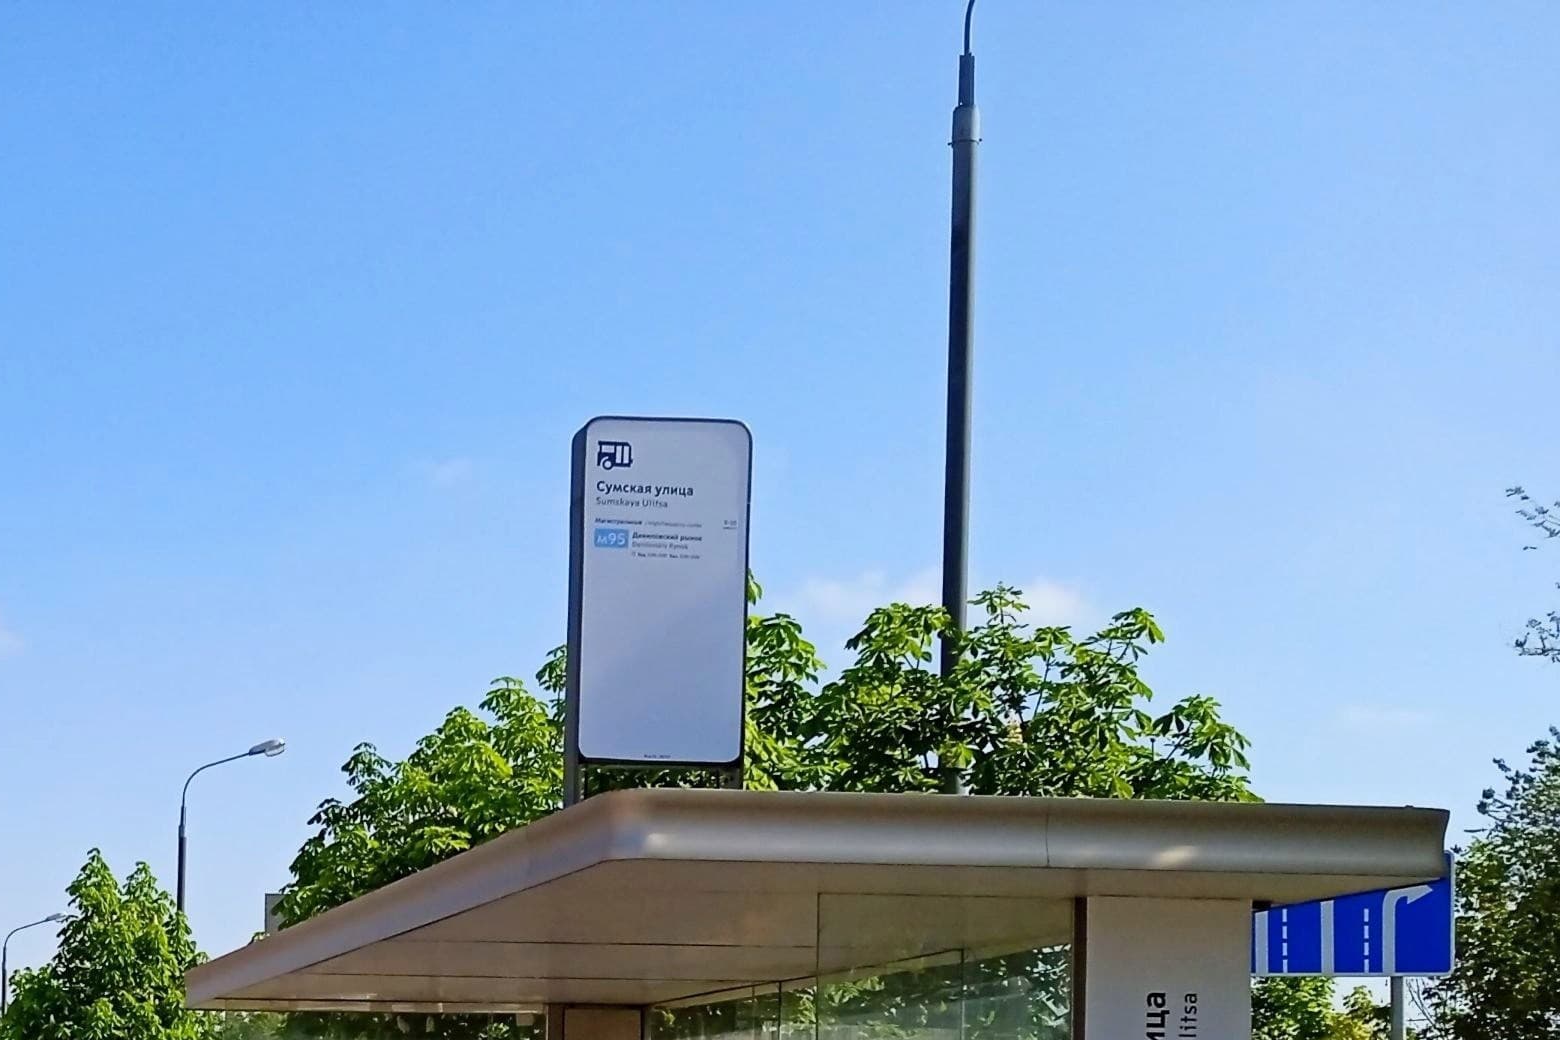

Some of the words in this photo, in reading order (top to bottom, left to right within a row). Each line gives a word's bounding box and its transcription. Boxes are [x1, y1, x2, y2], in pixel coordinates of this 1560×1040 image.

[596, 480, 652, 495] Сумская
[654, 485, 694, 498] улица
[596, 496, 640, 508] Sumskaya
[642, 498, 668, 508] Ulitsa
